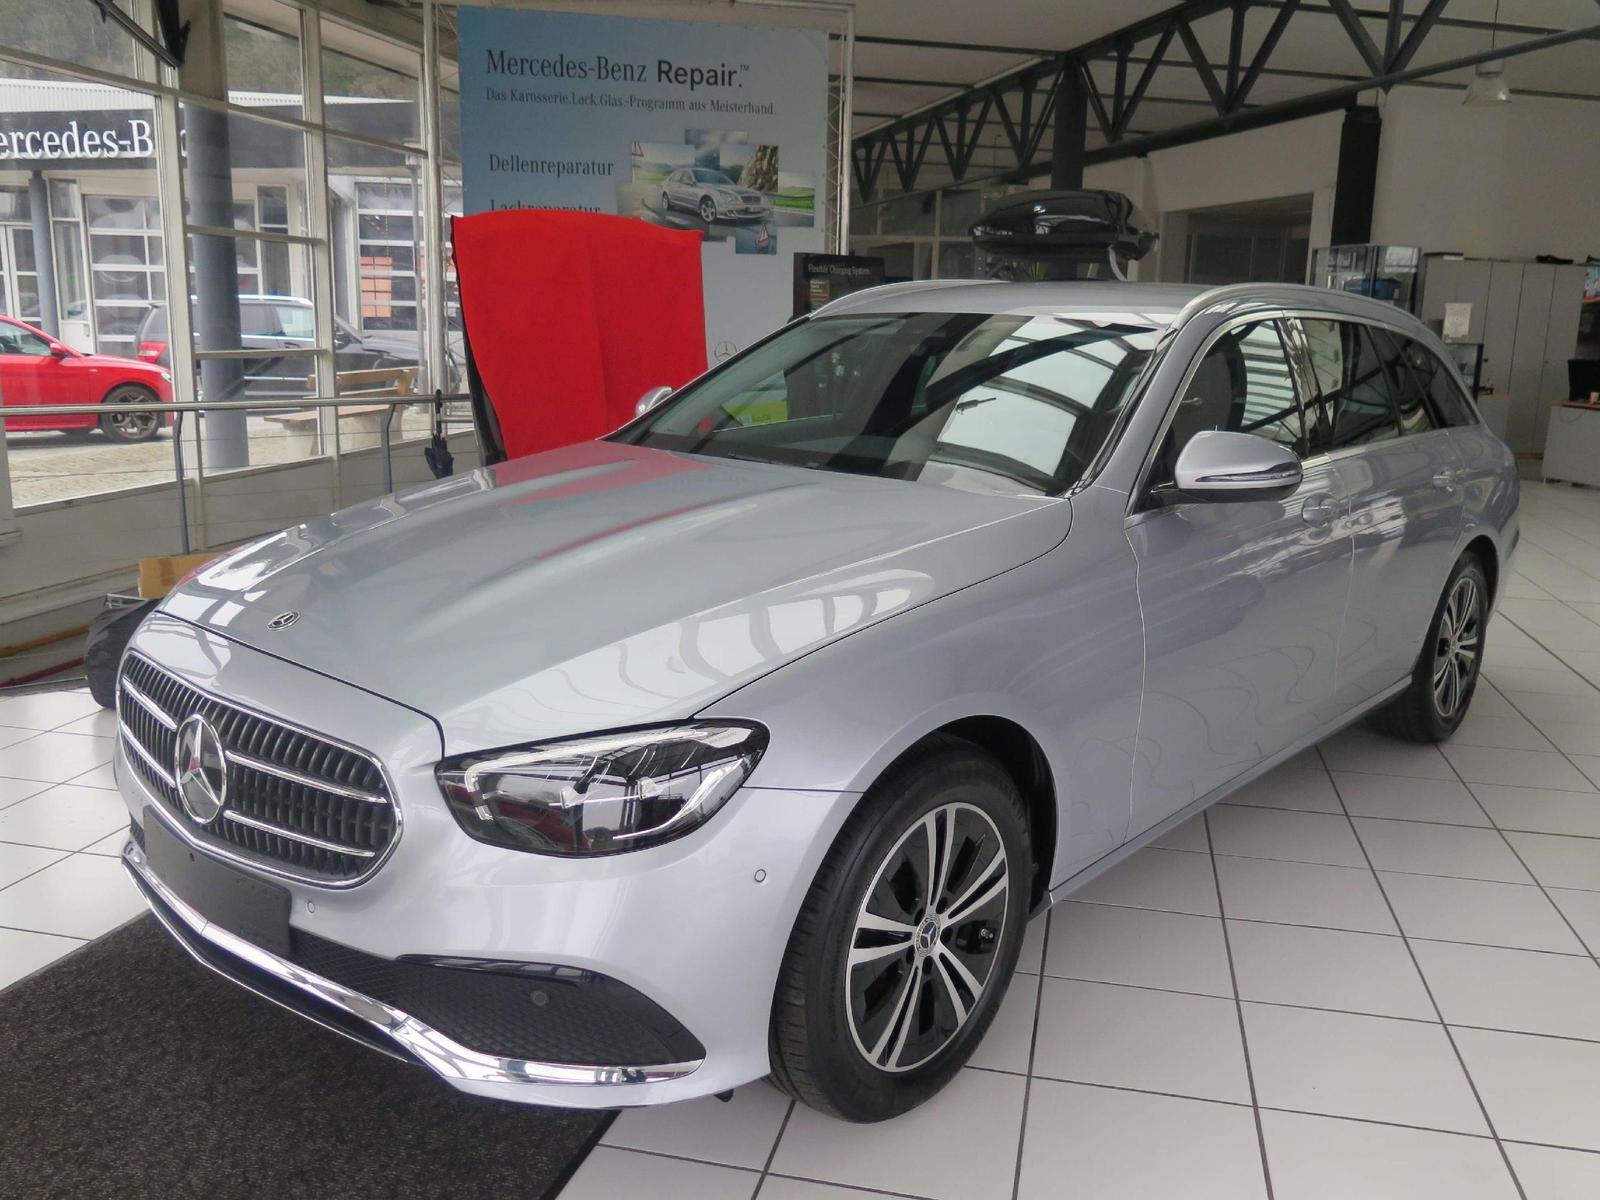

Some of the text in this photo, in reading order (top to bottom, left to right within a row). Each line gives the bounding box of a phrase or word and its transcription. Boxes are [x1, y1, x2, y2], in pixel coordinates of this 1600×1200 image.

[486, 49, 648, 83] Mercedes-Benz
[486, 87, 507, 102] Das
[688, 101, 707, 112] aus
[488, 153, 615, 178] Dellenreparatur
